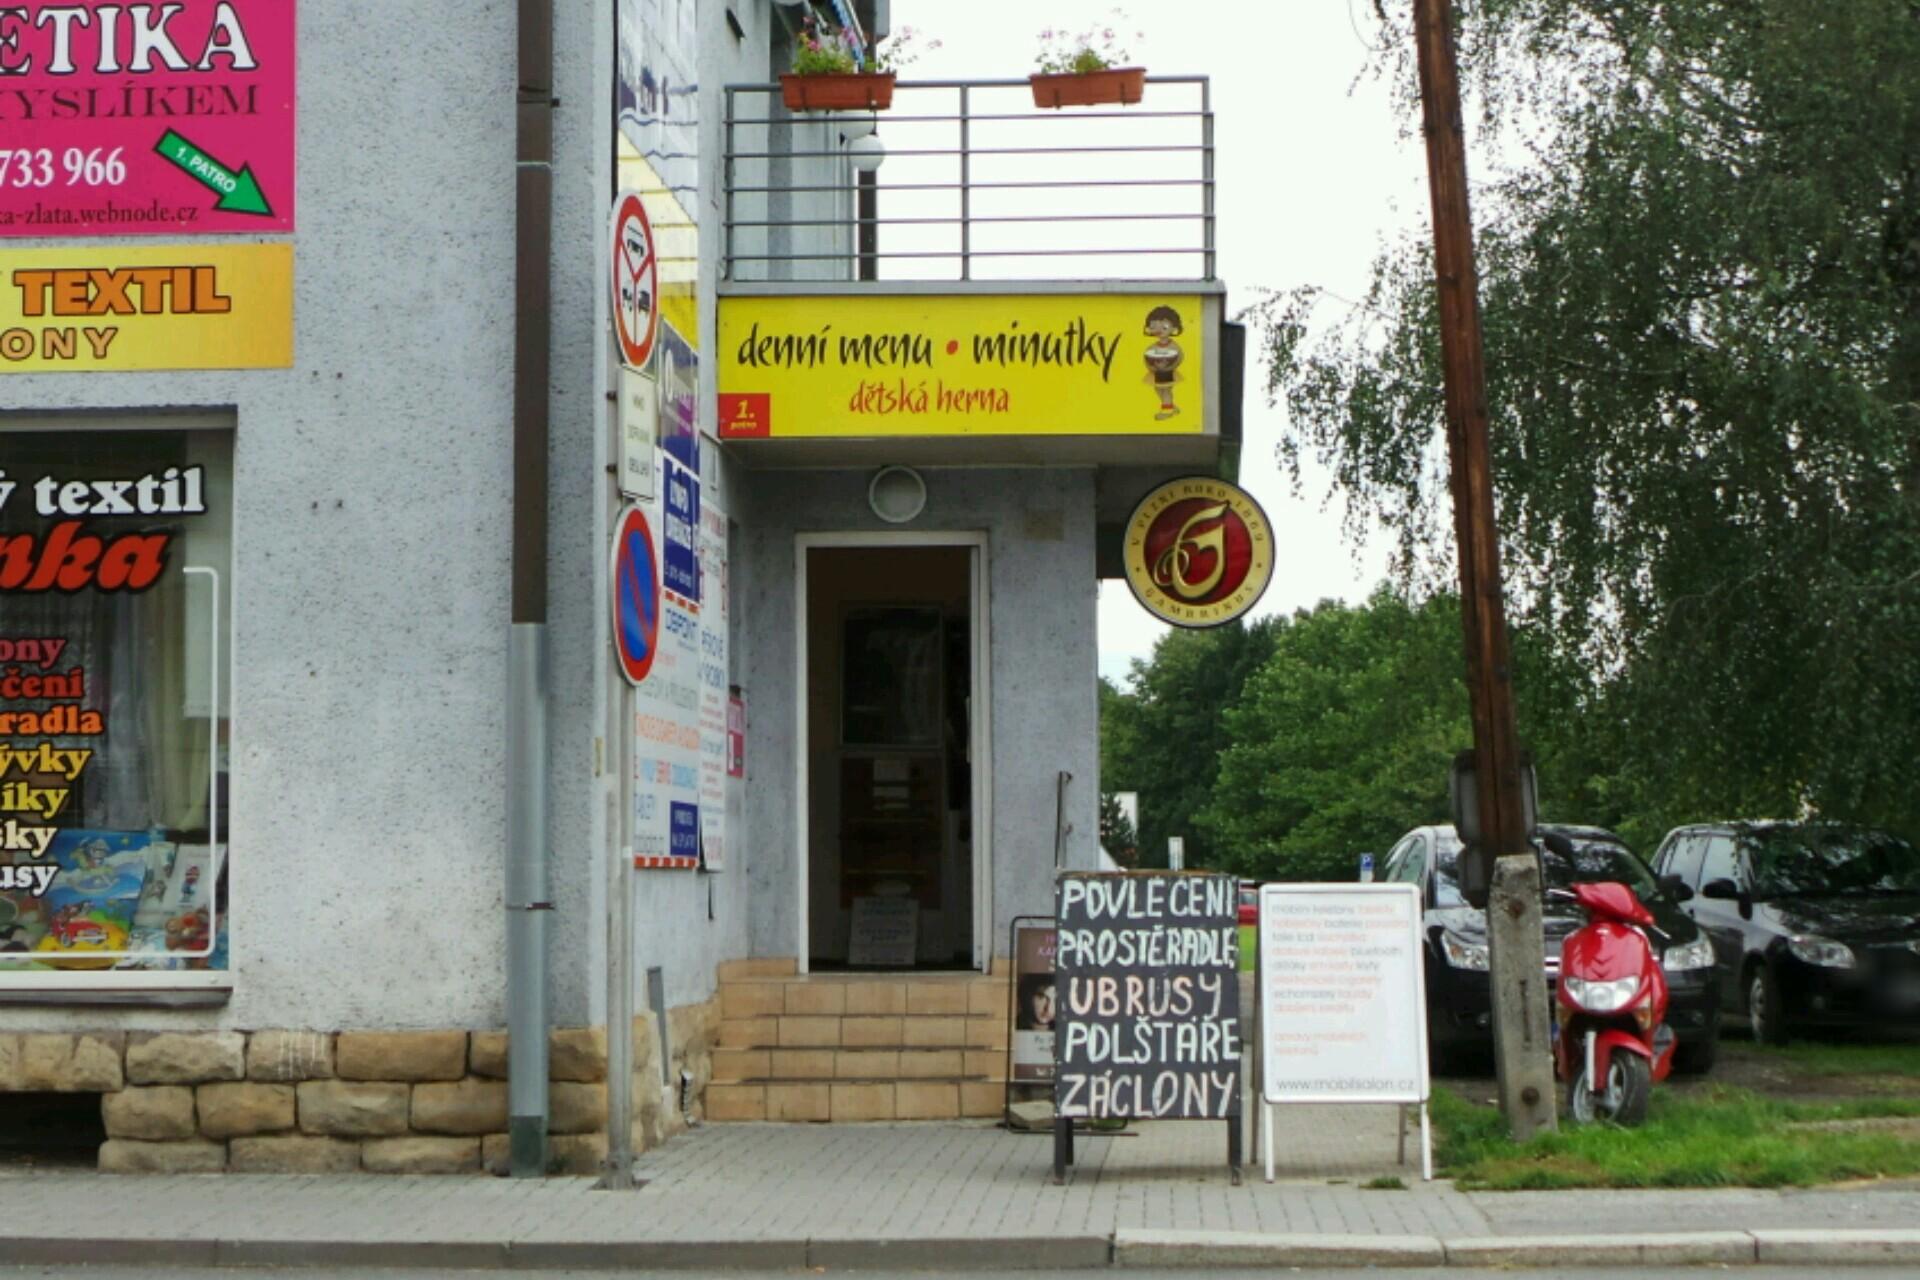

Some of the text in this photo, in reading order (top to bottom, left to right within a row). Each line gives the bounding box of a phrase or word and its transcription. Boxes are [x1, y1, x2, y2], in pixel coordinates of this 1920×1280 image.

[0, 81, 260, 120] YSLÍKEM
[63, 147, 126, 186] 966
[176, 147, 236, 193] 1. PATRO
[13, 265, 232, 316] TEXTIL
[0, 327, 118, 360] ONY
[737, 317, 1122, 382] denní menu minutky
[736, 399, 755, 419] 1.
[849, 378, 1010, 415] dětská herna
[33, 466, 206, 516] textil
[1, 667, 83, 698] čení
[1, 782, 69, 819] íky
[0, 819, 58, 858] ky
[1069, 973, 1221, 1019] UBRUSY
[1060, 1070, 1235, 1118] ZÁCLONY
